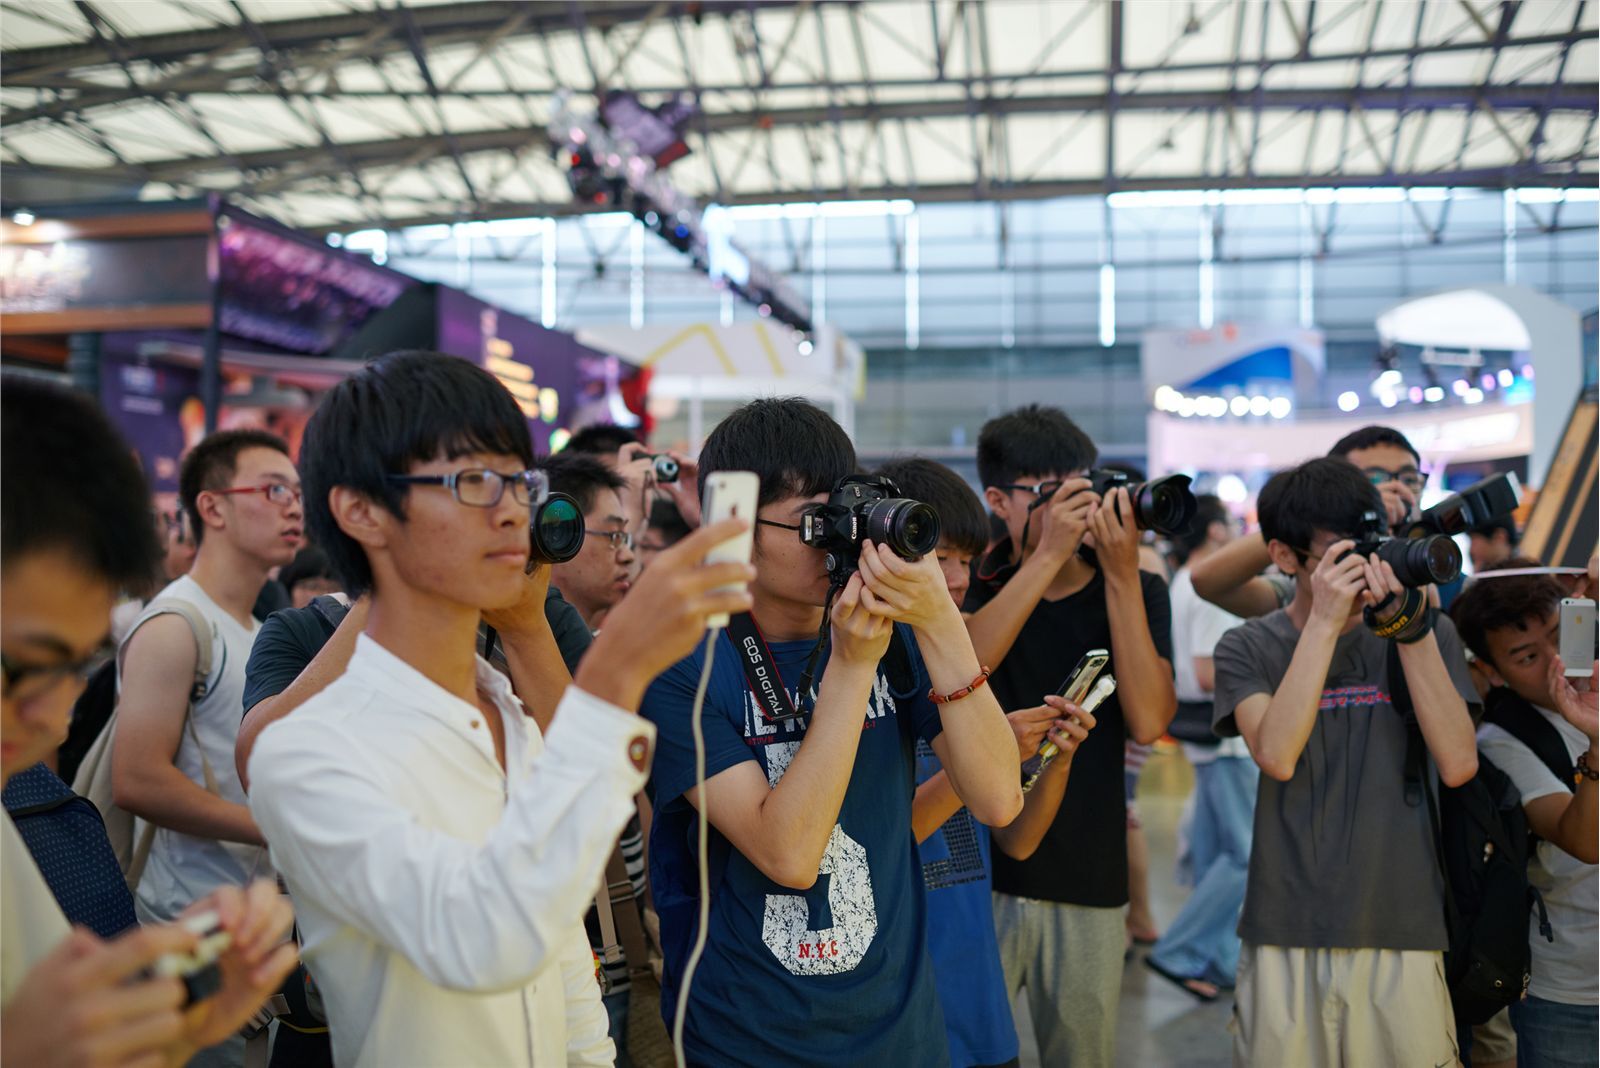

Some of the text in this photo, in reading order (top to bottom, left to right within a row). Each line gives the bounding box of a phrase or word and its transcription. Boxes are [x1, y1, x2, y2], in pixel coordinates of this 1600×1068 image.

[743, 636, 763, 664] EOS
[755, 666, 783, 715] DIGITAL
[799, 940, 838, 959] N.Y.C
